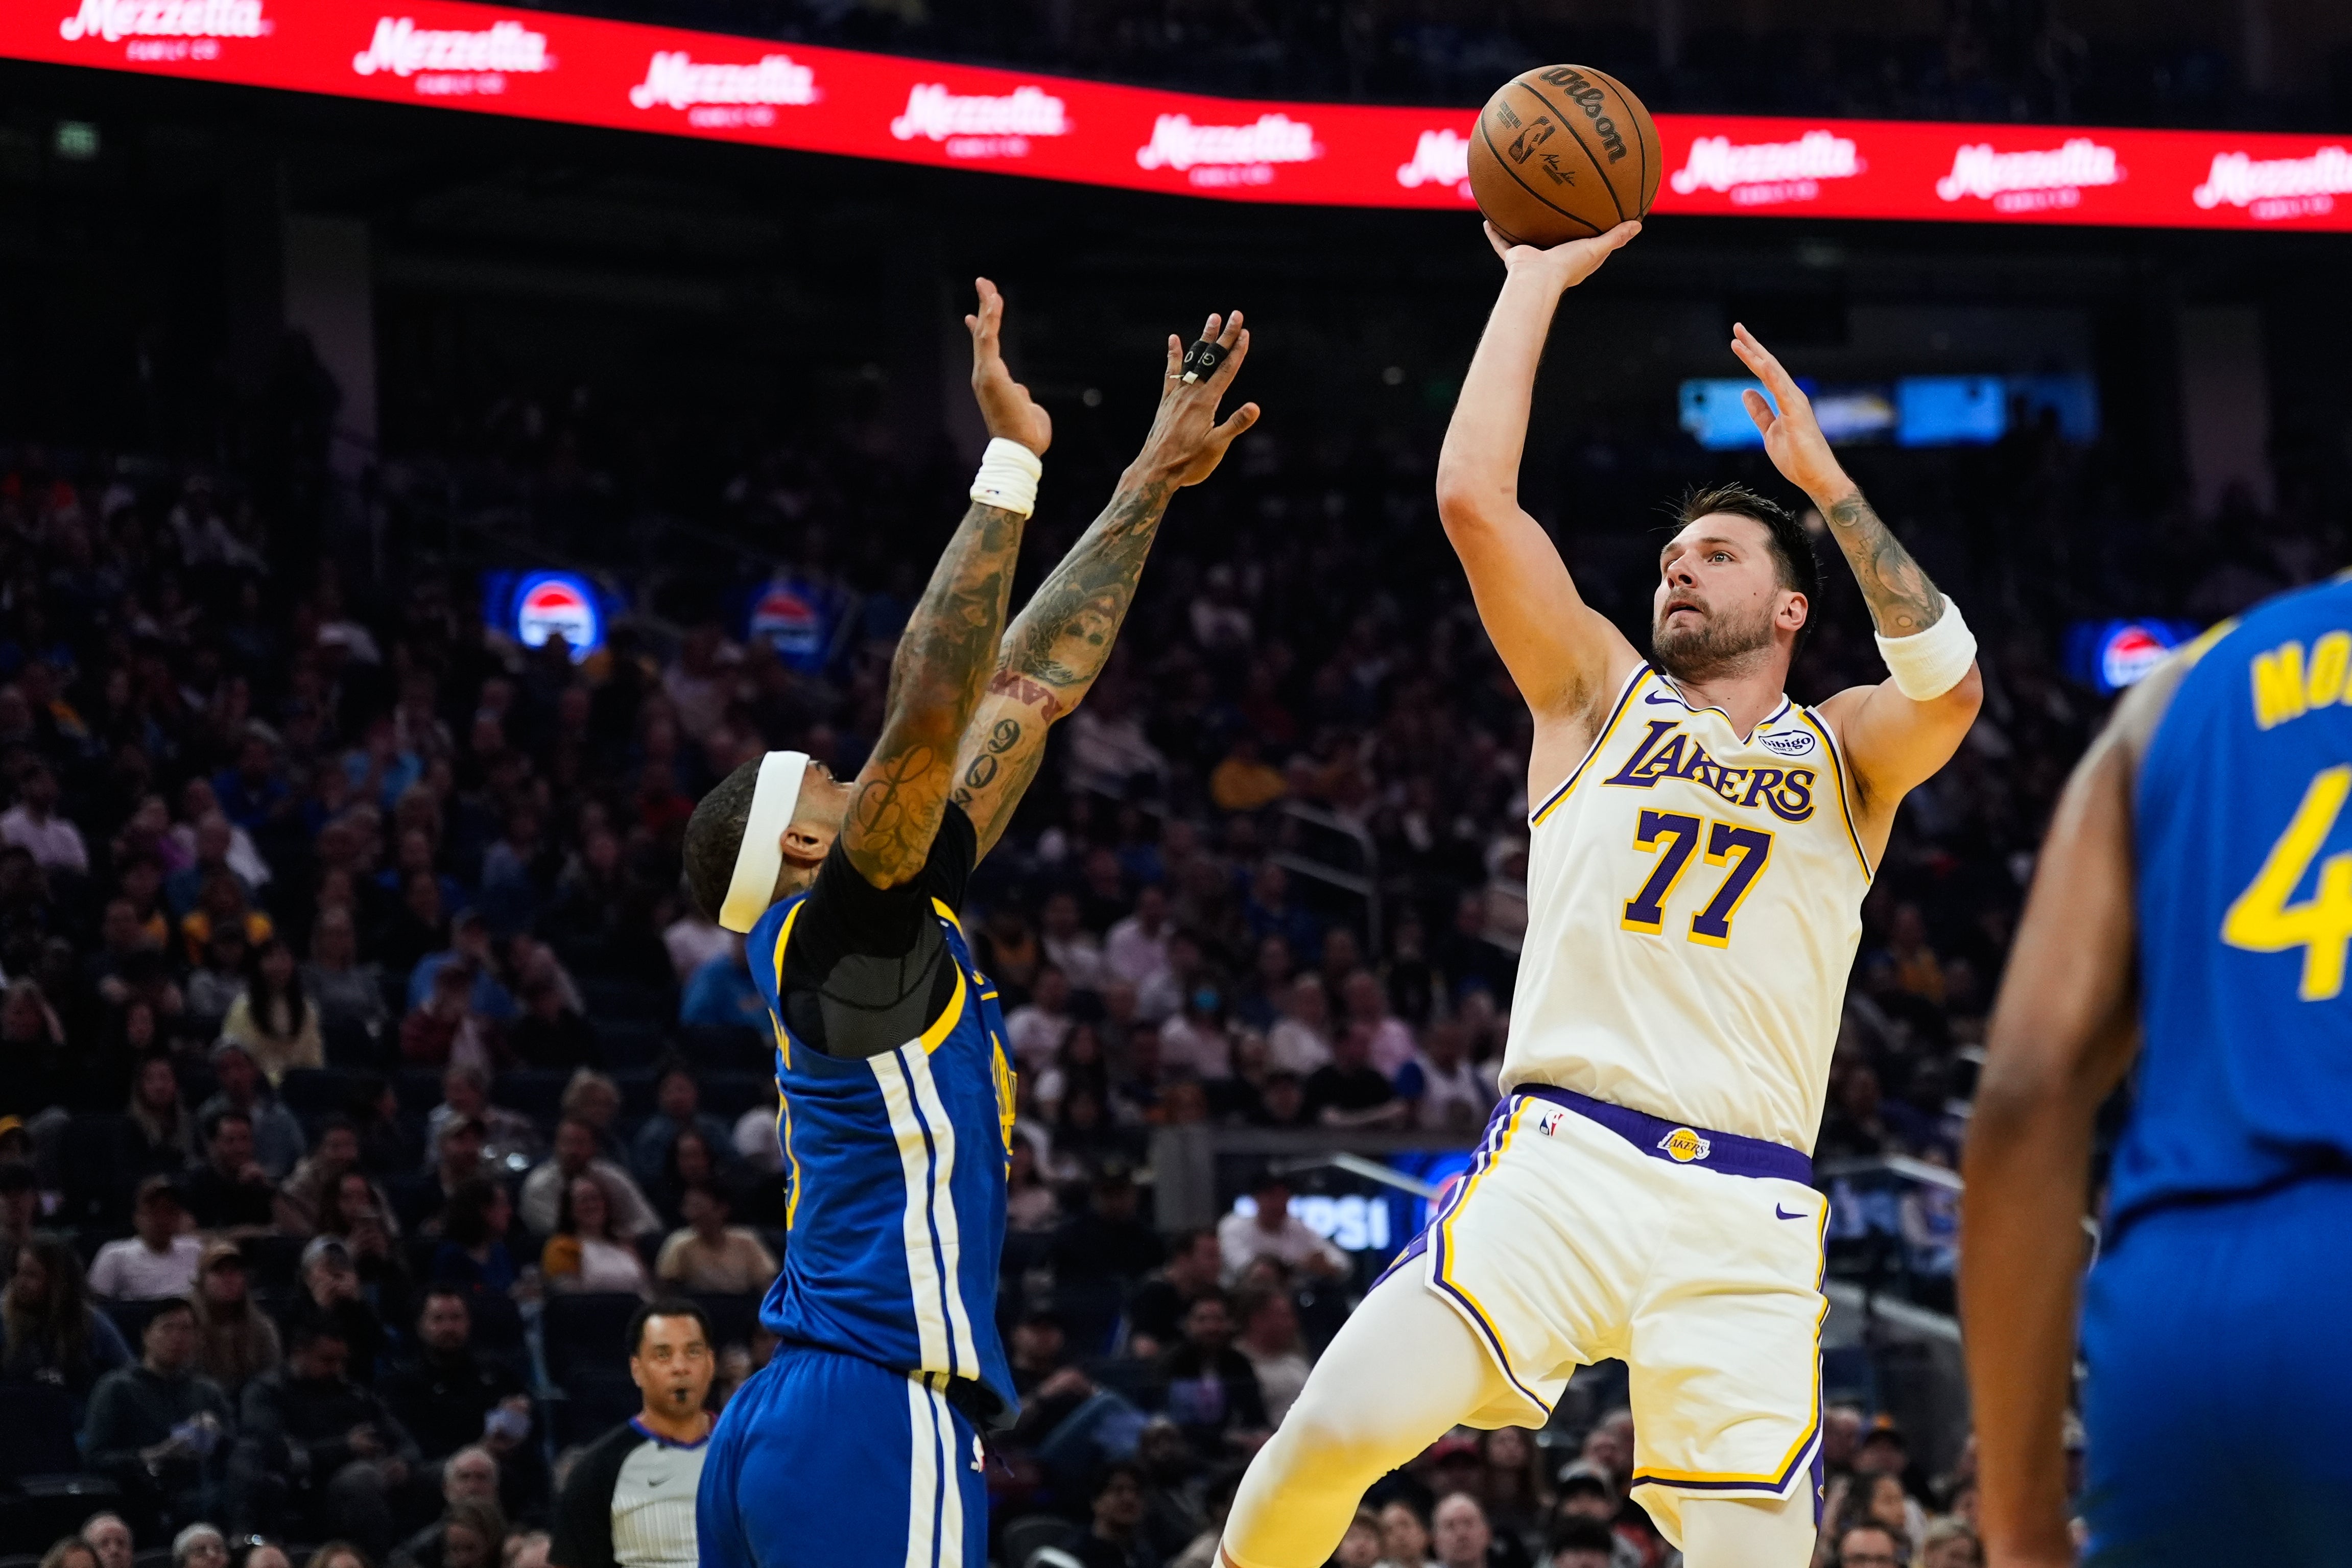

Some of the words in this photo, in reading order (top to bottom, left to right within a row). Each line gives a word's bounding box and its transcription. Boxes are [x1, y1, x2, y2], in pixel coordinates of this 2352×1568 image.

[352, 16, 547, 77] Mezzetta
[1538, 66, 1627, 165] Wilson
[2250, 629, 2352, 731] MO
[1599, 718, 1818, 824] LAKERS
[1762, 738, 1811, 749] bibigo
[1620, 806, 1776, 950] 77
[2221, 763, 2352, 1002] 4
[1659, 1133, 1707, 1158] LAKERS
